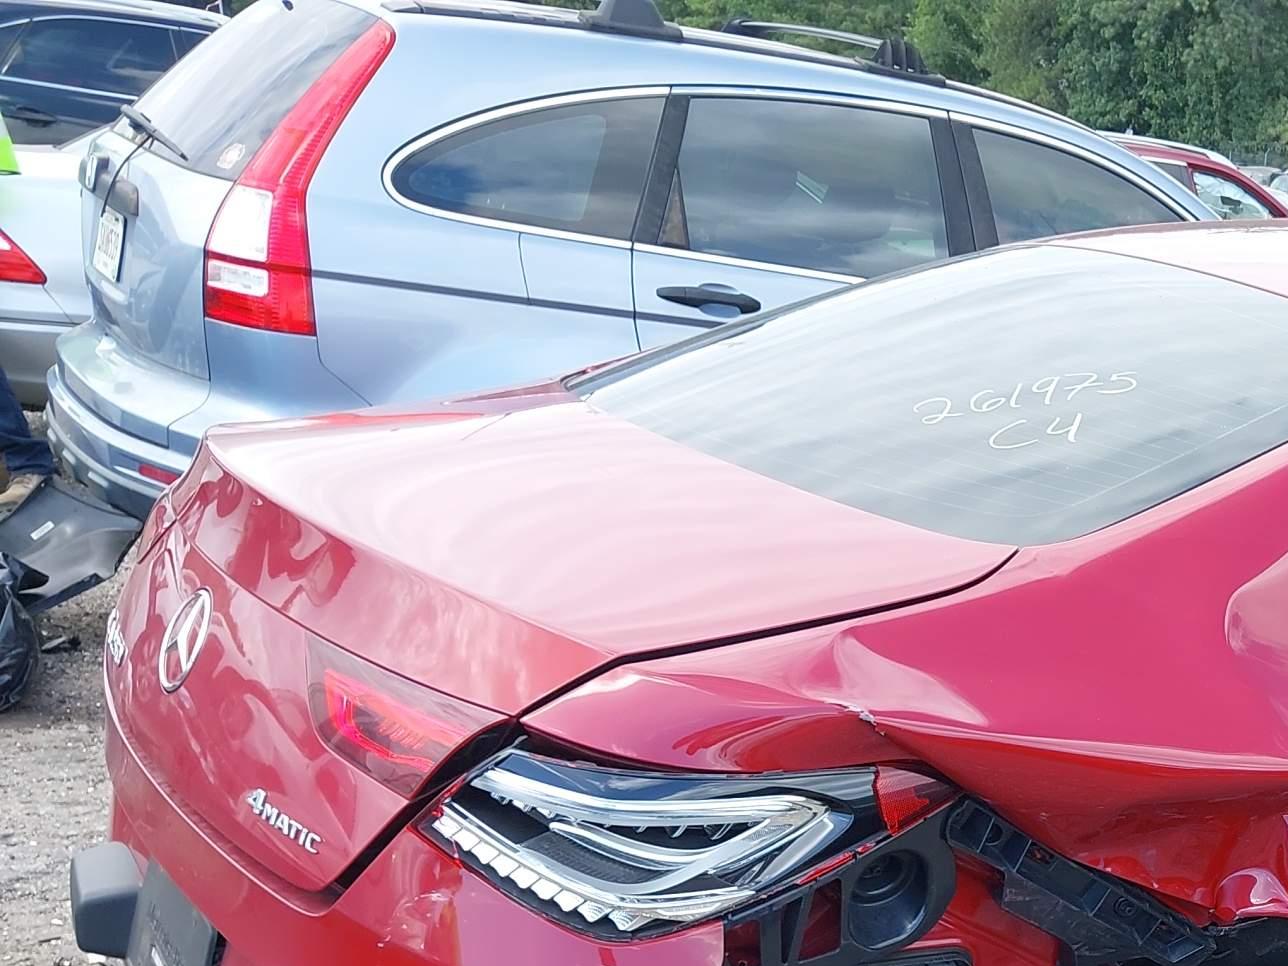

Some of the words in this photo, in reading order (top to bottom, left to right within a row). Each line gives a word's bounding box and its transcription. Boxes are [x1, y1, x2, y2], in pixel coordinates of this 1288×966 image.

[912, 371, 1138, 425] 261975
[988, 412, 1083, 449] C4
[246, 788, 323, 854] 4MATIC
